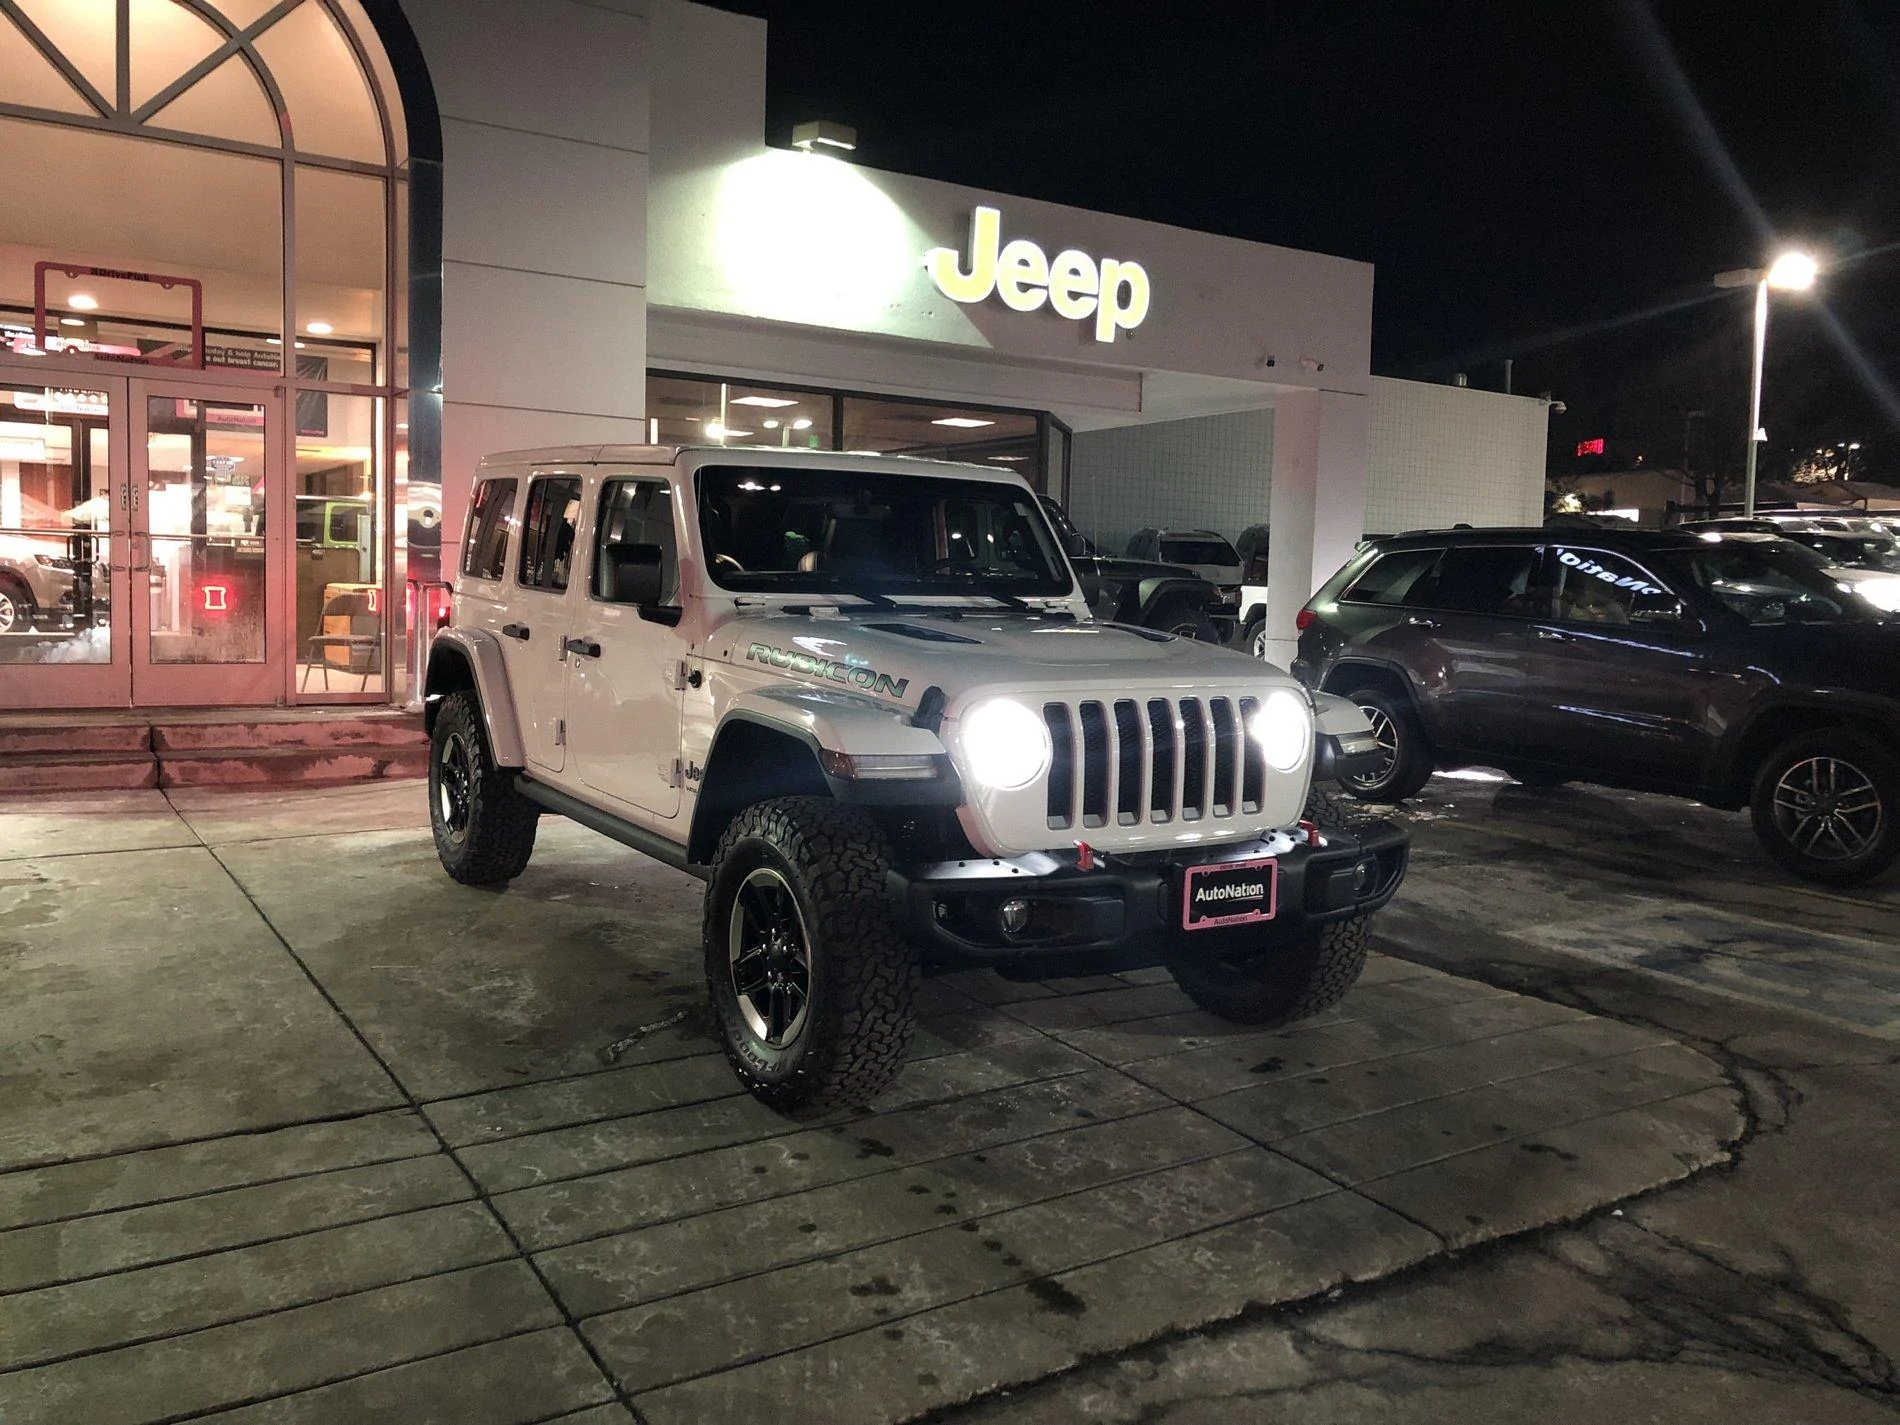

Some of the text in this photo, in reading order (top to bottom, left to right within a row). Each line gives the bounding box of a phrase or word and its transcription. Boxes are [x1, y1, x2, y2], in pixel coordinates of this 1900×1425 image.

[924, 205, 1150, 343] Jeep
[94, 353, 149, 365] AutoNation
[228, 357, 251, 365] breast
[254, 352, 280, 361] AutoNa
[746, 642, 909, 698] RUBICON
[685, 760, 703, 782] Je
[1195, 882, 1264, 902] AutoNation
